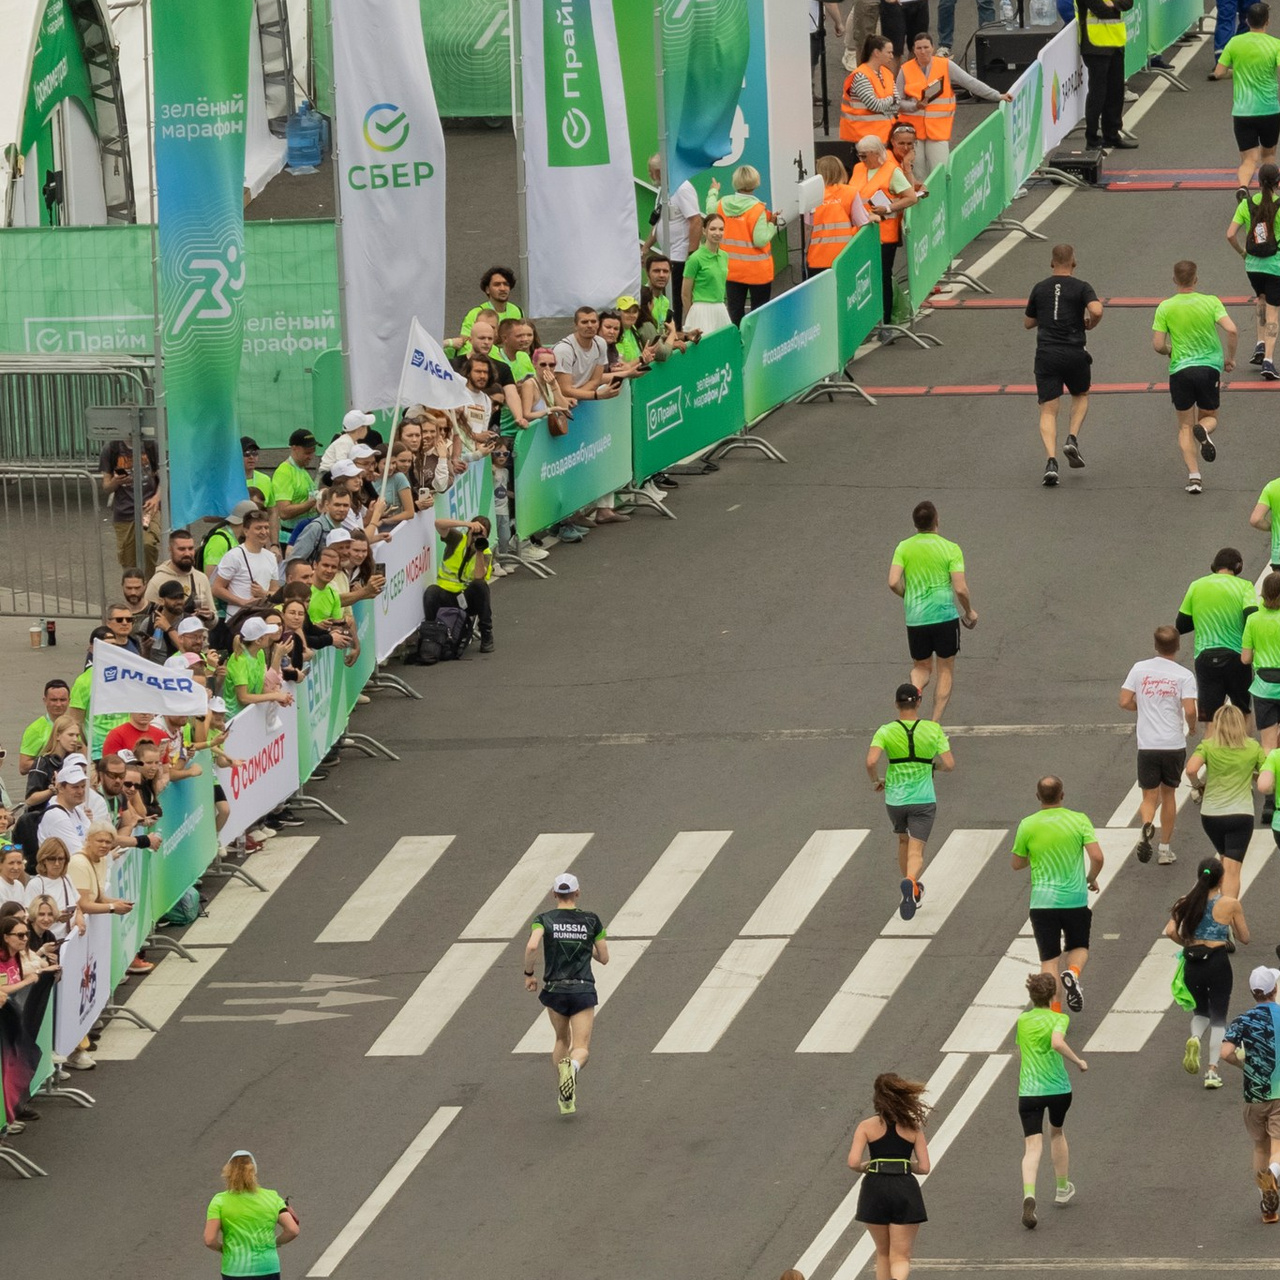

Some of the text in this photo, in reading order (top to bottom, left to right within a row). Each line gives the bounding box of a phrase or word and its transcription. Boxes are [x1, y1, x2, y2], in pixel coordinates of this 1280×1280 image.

[161, 94, 244, 118] зелёный
[161, 119, 243, 141] марафон
[347, 161, 434, 191] СБЕР
[67, 329, 146, 353] Прайм
[241, 333, 327, 358] арафон
[552, 922, 588, 933] RUSSIA
[552, 931, 588, 940] RUNNING
